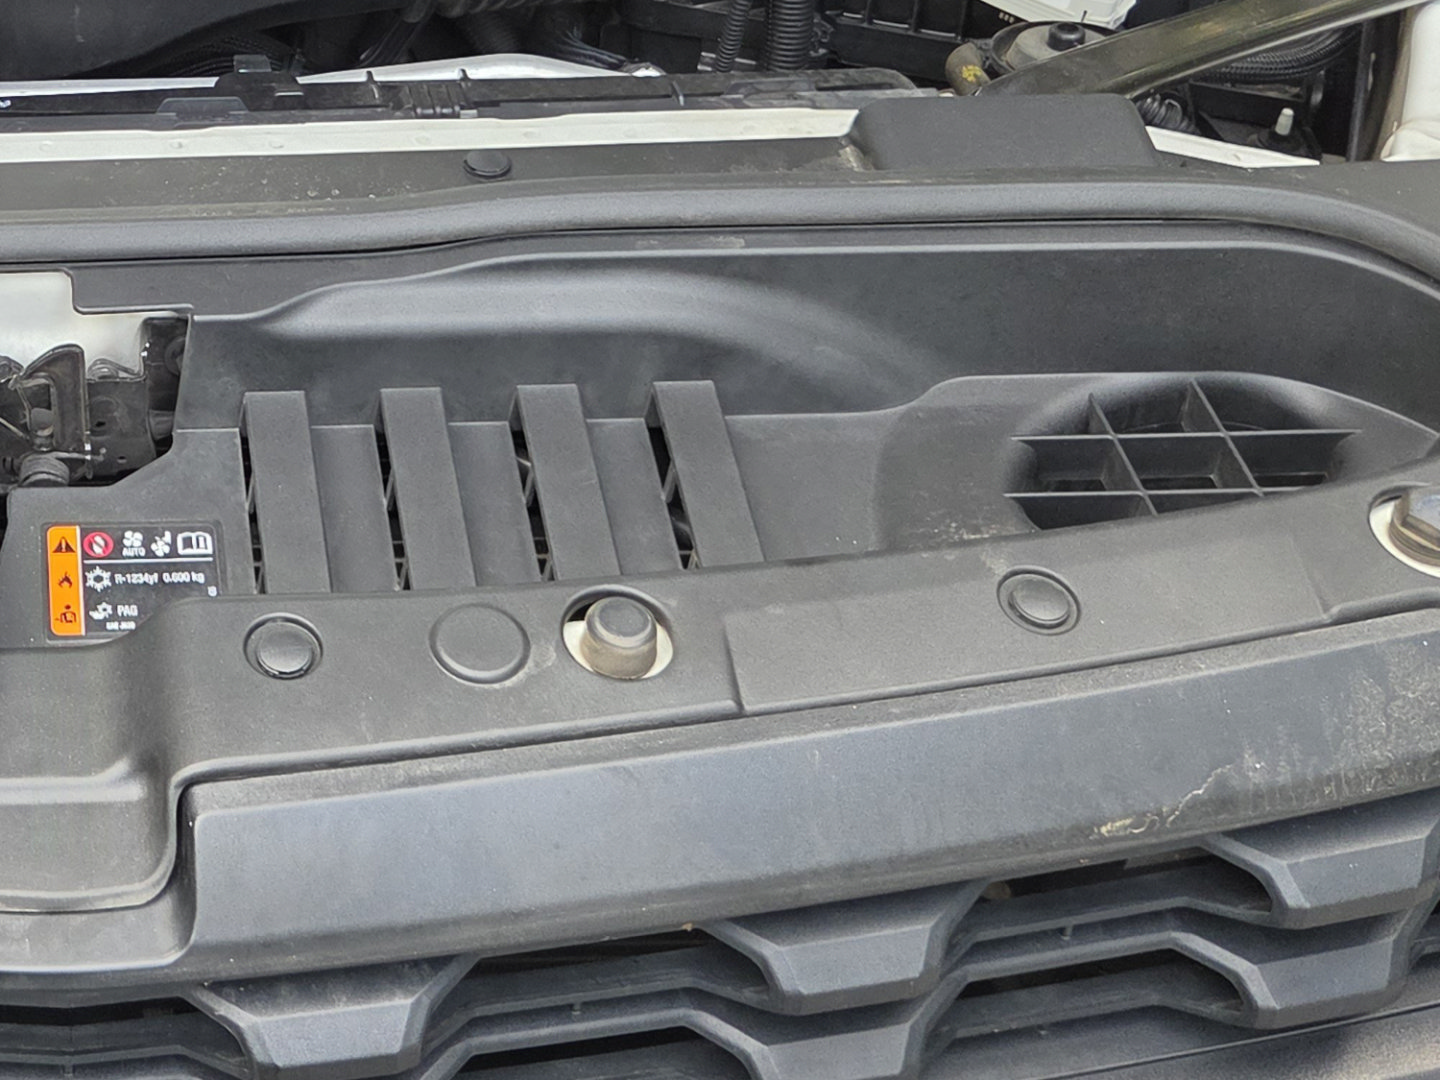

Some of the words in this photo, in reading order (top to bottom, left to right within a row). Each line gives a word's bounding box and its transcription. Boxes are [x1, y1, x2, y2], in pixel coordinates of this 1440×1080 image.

[122, 547, 146, 557] AUTO
[114, 572, 159, 585] R-1234yf
[191, 572, 205, 585] kg
[116, 604, 139, 618] PAG
